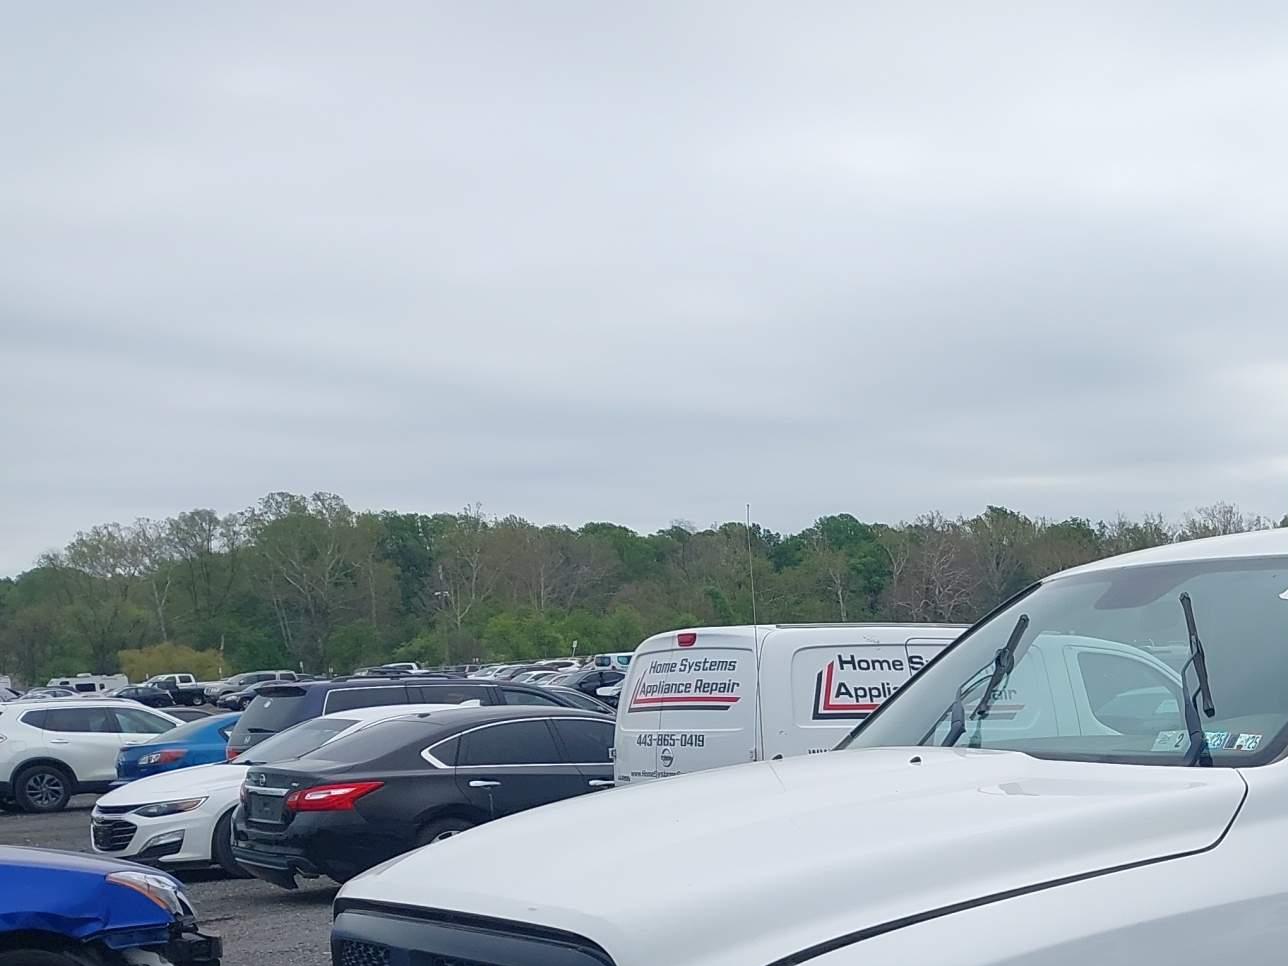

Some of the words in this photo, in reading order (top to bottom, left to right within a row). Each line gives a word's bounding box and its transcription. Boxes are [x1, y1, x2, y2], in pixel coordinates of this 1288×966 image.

[649, 660, 677, 674] Home
[679, 657, 737, 674] Systems
[837, 654, 904, 671] Home
[908, 655, 928, 671] S
[640, 680, 691, 697] Appliance
[694, 678, 740, 695] Repair
[636, 734, 705, 747] 443-865-0419
